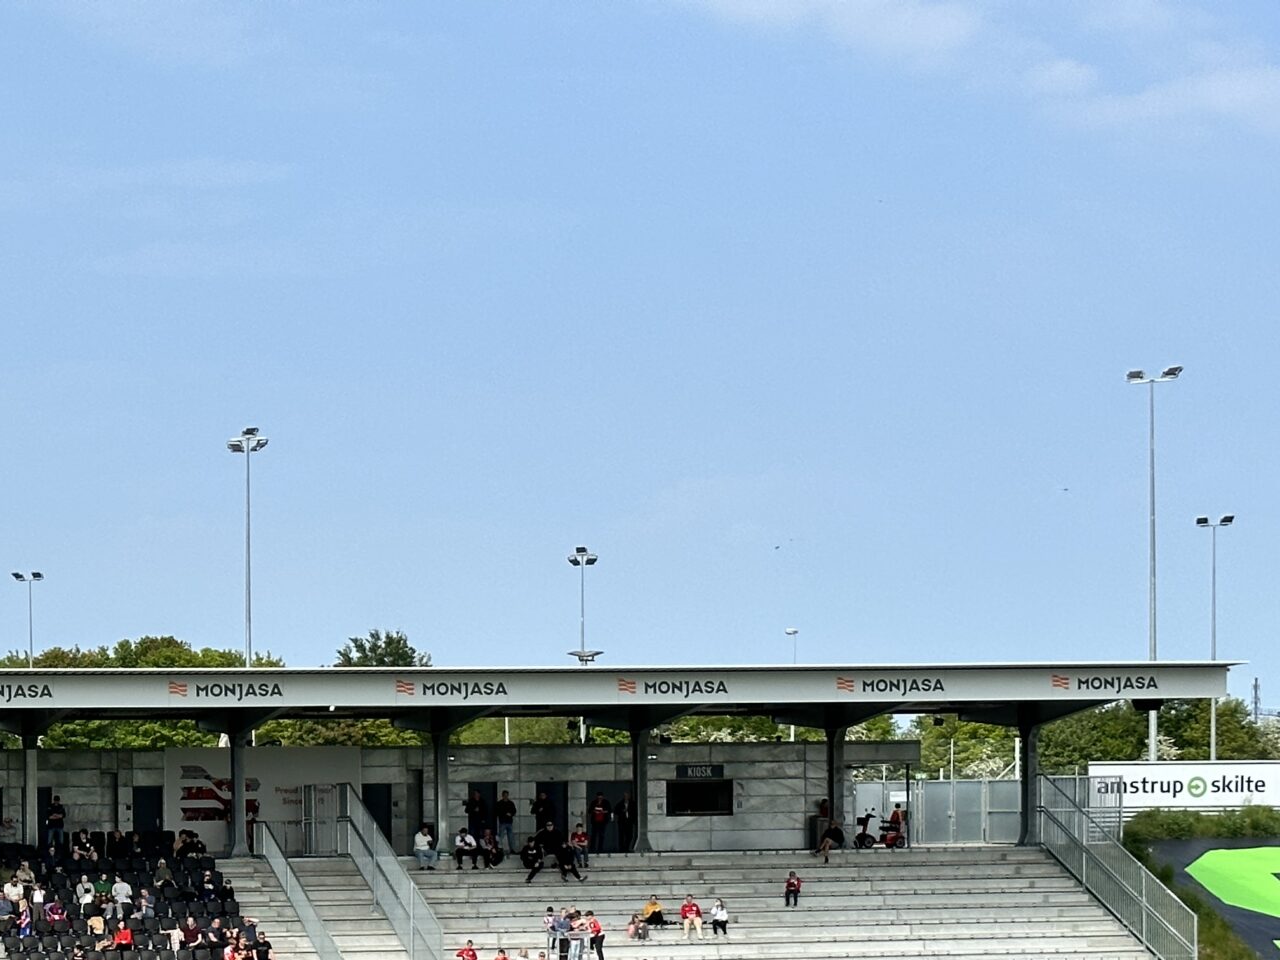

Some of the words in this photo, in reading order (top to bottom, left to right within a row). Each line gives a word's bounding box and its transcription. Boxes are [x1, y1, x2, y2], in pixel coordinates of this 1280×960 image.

[195, 683, 283, 702] MONJASA
[422, 681, 508, 700] MONJASA
[644, 681, 728, 698] MONJASA
[862, 679, 945, 696] MONJASA
[1077, 678, 1158, 694] MONJASA
[687, 766, 713, 777] KIOSK
[1097, 777, 1184, 798] amstrup
[1211, 775, 1266, 793] skilte
